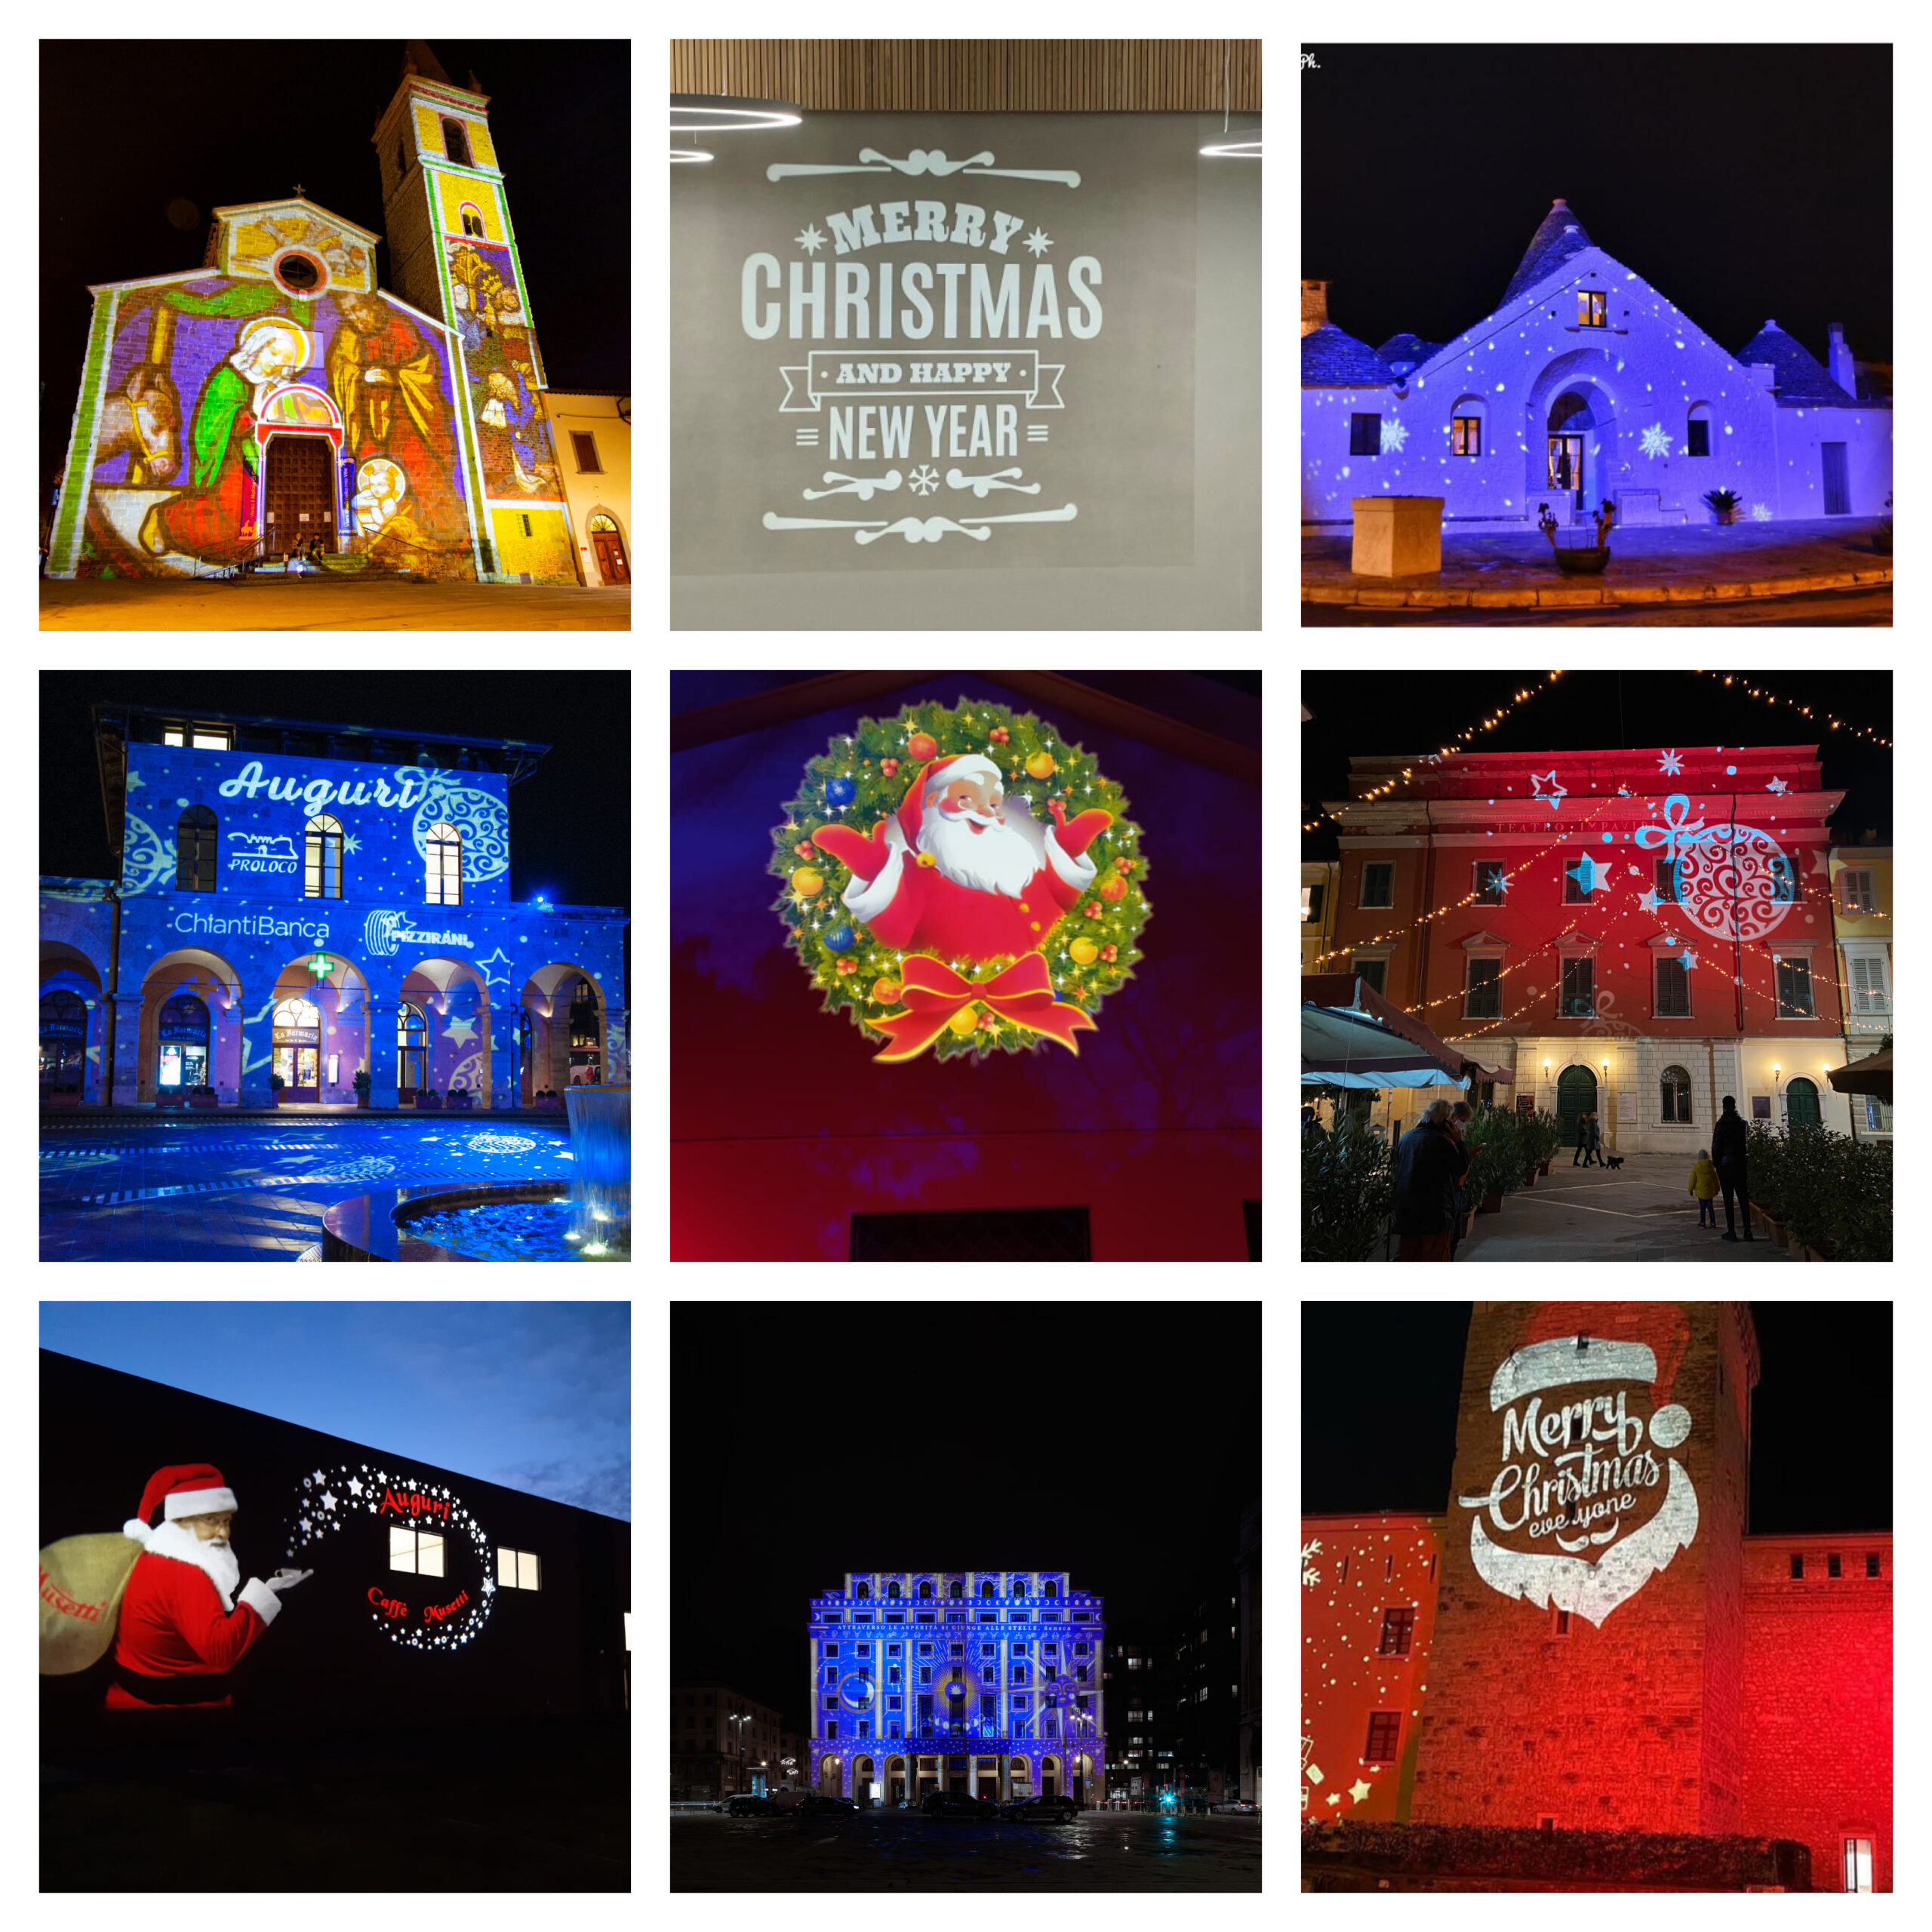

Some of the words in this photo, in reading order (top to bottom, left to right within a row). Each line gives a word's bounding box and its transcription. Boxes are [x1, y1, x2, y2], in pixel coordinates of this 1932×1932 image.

[826, 200, 1023, 255] MERRY
[741, 252, 1103, 340] CHRISTMAS
[836, 363, 902, 383] AND
[910, 362, 1011, 383] HAPPY
[829, 405, 914, 460] NEW
[924, 404, 1017, 457] YEAR
[219, 761, 417, 817] Auguri
[1496, 823, 1564, 833] TEATRO
[1580, 821, 1656, 832] IMPAVIDI
[230, 859, 297, 874] PROLOCO
[175, 912, 330, 938] ChiantiBanca
[275, 1032, 285, 1040] La
[286, 1029, 318, 1041] Farmacia
[1502, 1391, 1644, 1462] Merry
[380, 1487, 451, 1521] Auguri
[1458, 1443, 1664, 1531] Christmas
[1529, 1494, 1636, 1538] eveyone
[368, 1587, 408, 1619] Caffè
[423, 1589, 469, 1623] Musetti
